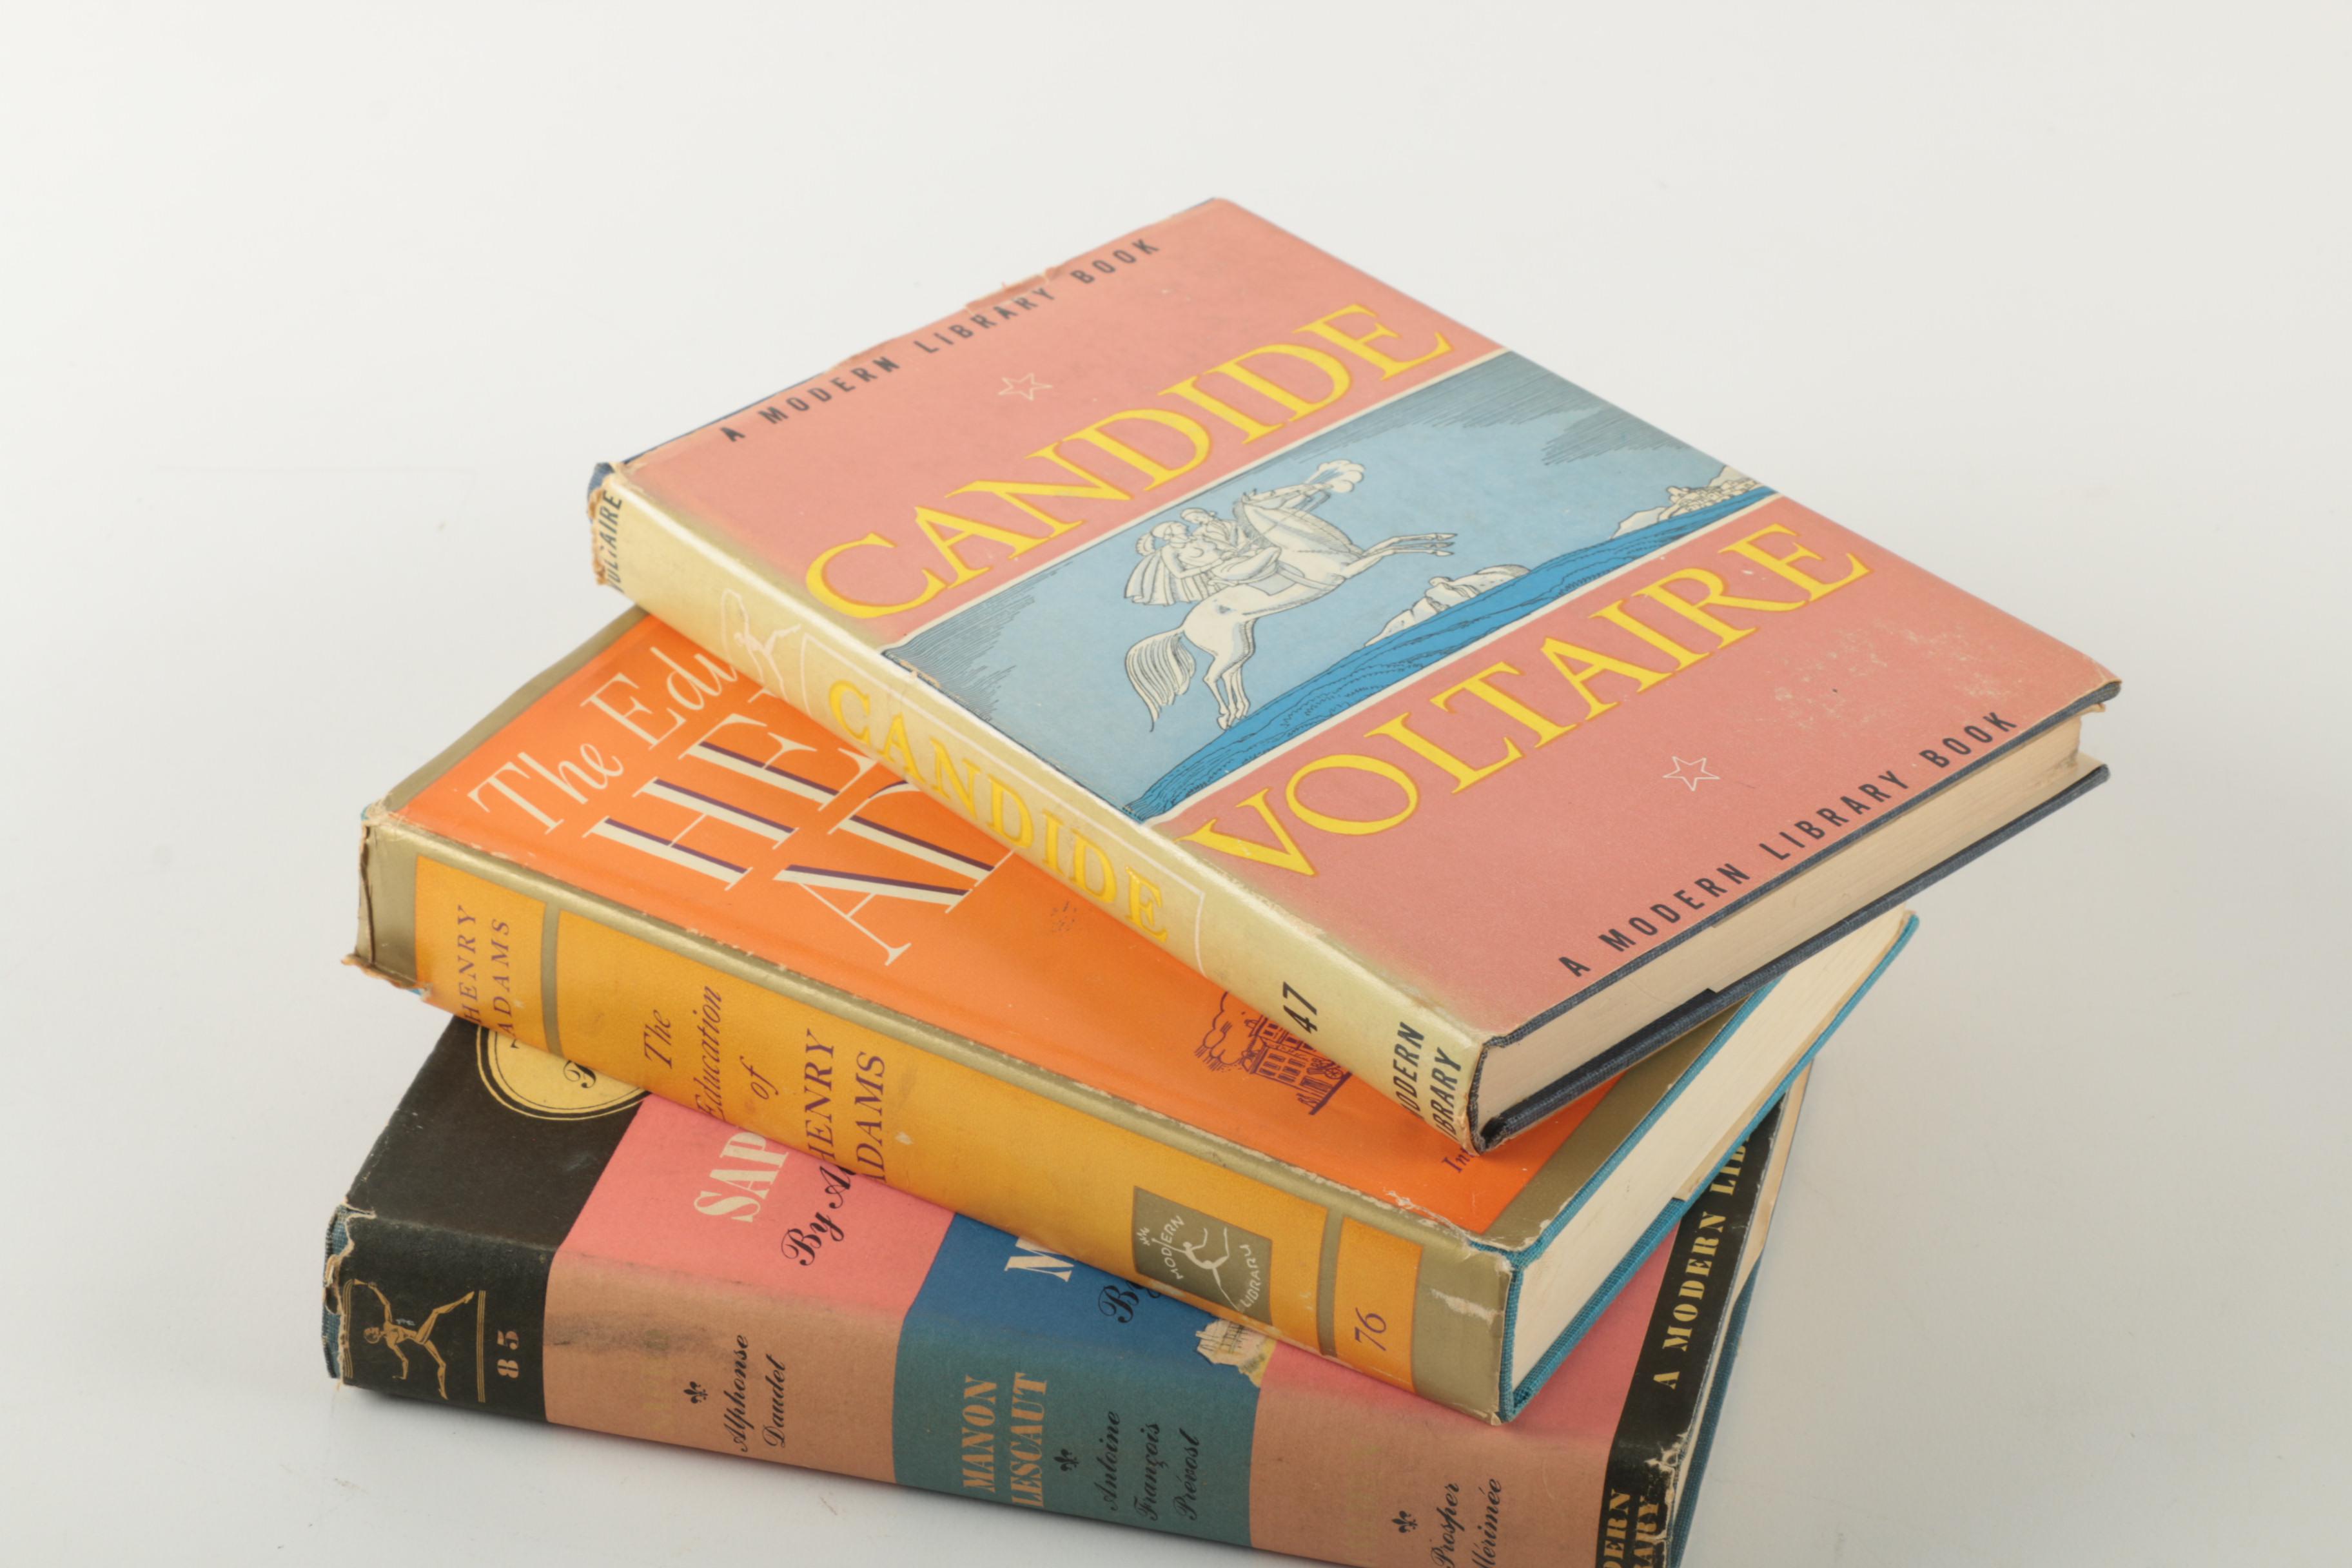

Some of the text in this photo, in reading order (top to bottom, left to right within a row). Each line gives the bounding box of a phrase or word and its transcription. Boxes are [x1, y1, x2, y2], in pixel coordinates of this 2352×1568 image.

[720, 239, 1160, 442] A MODERN LIBRARY BOOK
[805, 304, 1453, 619] CANDIDE
[467, 646, 738, 834] The Edu
[1174, 523, 1870, 877] VOLTAIRE
[582, 688, 878, 891] HE
[828, 679, 1168, 944] CANDIDE
[1558, 710, 2017, 977] A MODERN LIBRARY BOOK
[457, 904, 482, 1024] HENRY
[491, 918, 516, 1038] ADAMS
[1282, 981, 1318, 1034] 47
[643, 1009, 672, 1070] The
[693, 985, 726, 1121] Education
[739, 1055, 779, 1101] of
[694, 1132, 789, 1223] SAP
[781, 1211, 845, 1266] By
[1661, 1211, 1726, 1352] MODERN
[1354, 1307, 1388, 1353] 76
[1652, 1371, 1680, 1390] A
[723, 1334, 755, 1453] Alphonse
[961, 1374, 997, 1494] MANON
[1009, 1371, 1048, 1508] LESCAUT
[1094, 1410, 1121, 1512] Antoine
